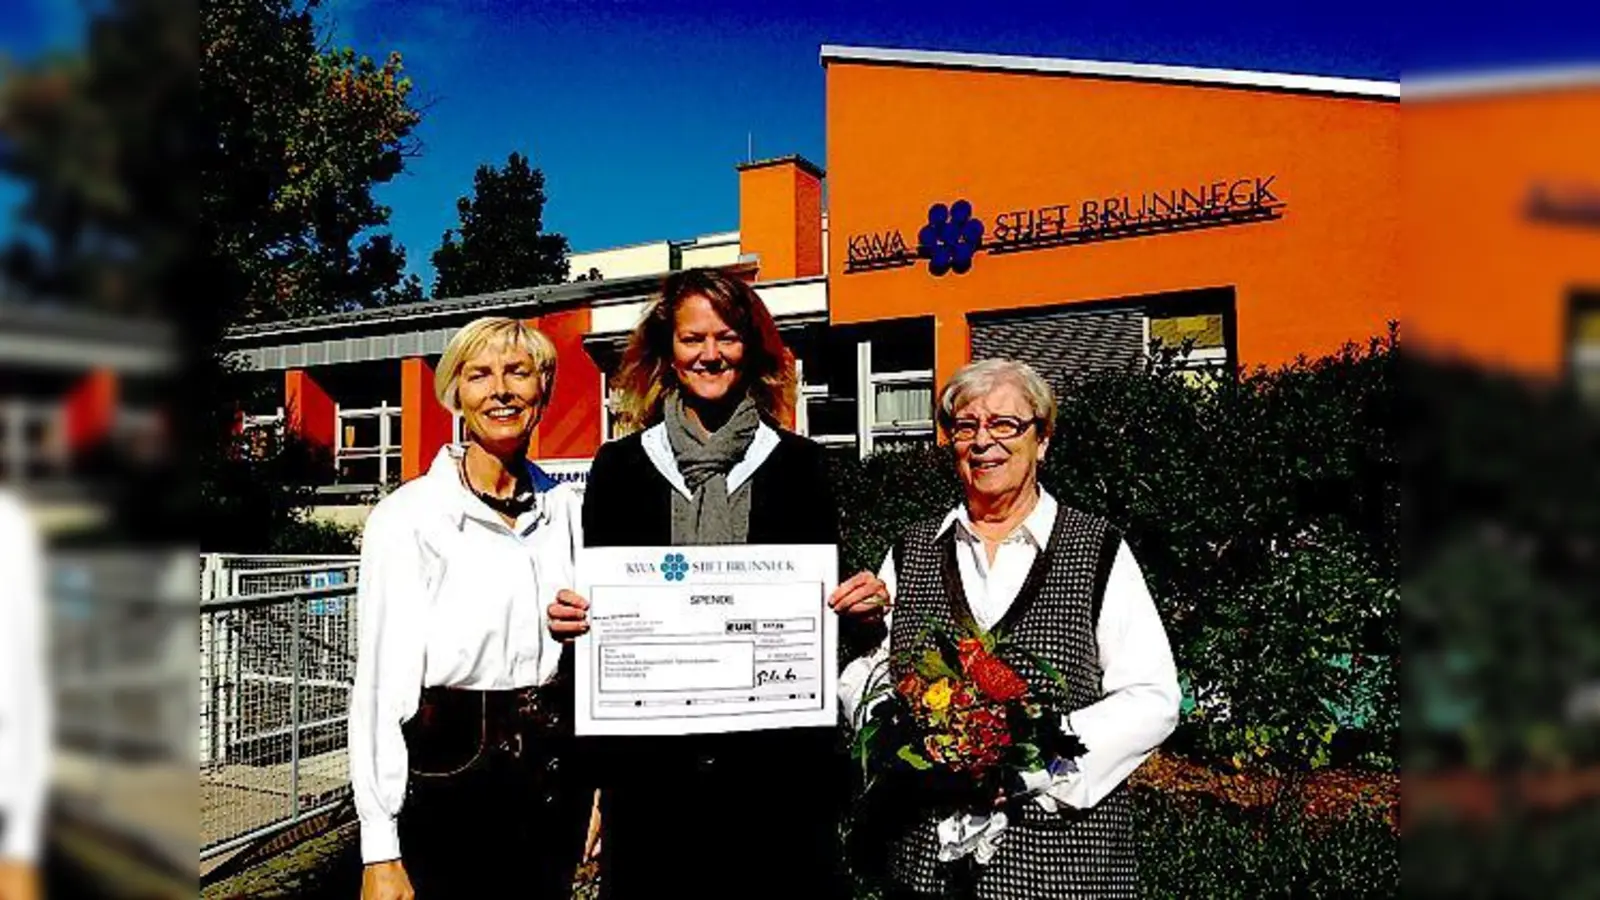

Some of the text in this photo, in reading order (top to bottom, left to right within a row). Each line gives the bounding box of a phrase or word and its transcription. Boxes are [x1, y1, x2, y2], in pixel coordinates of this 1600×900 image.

[848, 174, 1280, 260] KWA STIFT BRUNNECK
[625, 562, 656, 575] KWA
[690, 594, 735, 605] SPENDE
[726, 623, 752, 631] EUR
